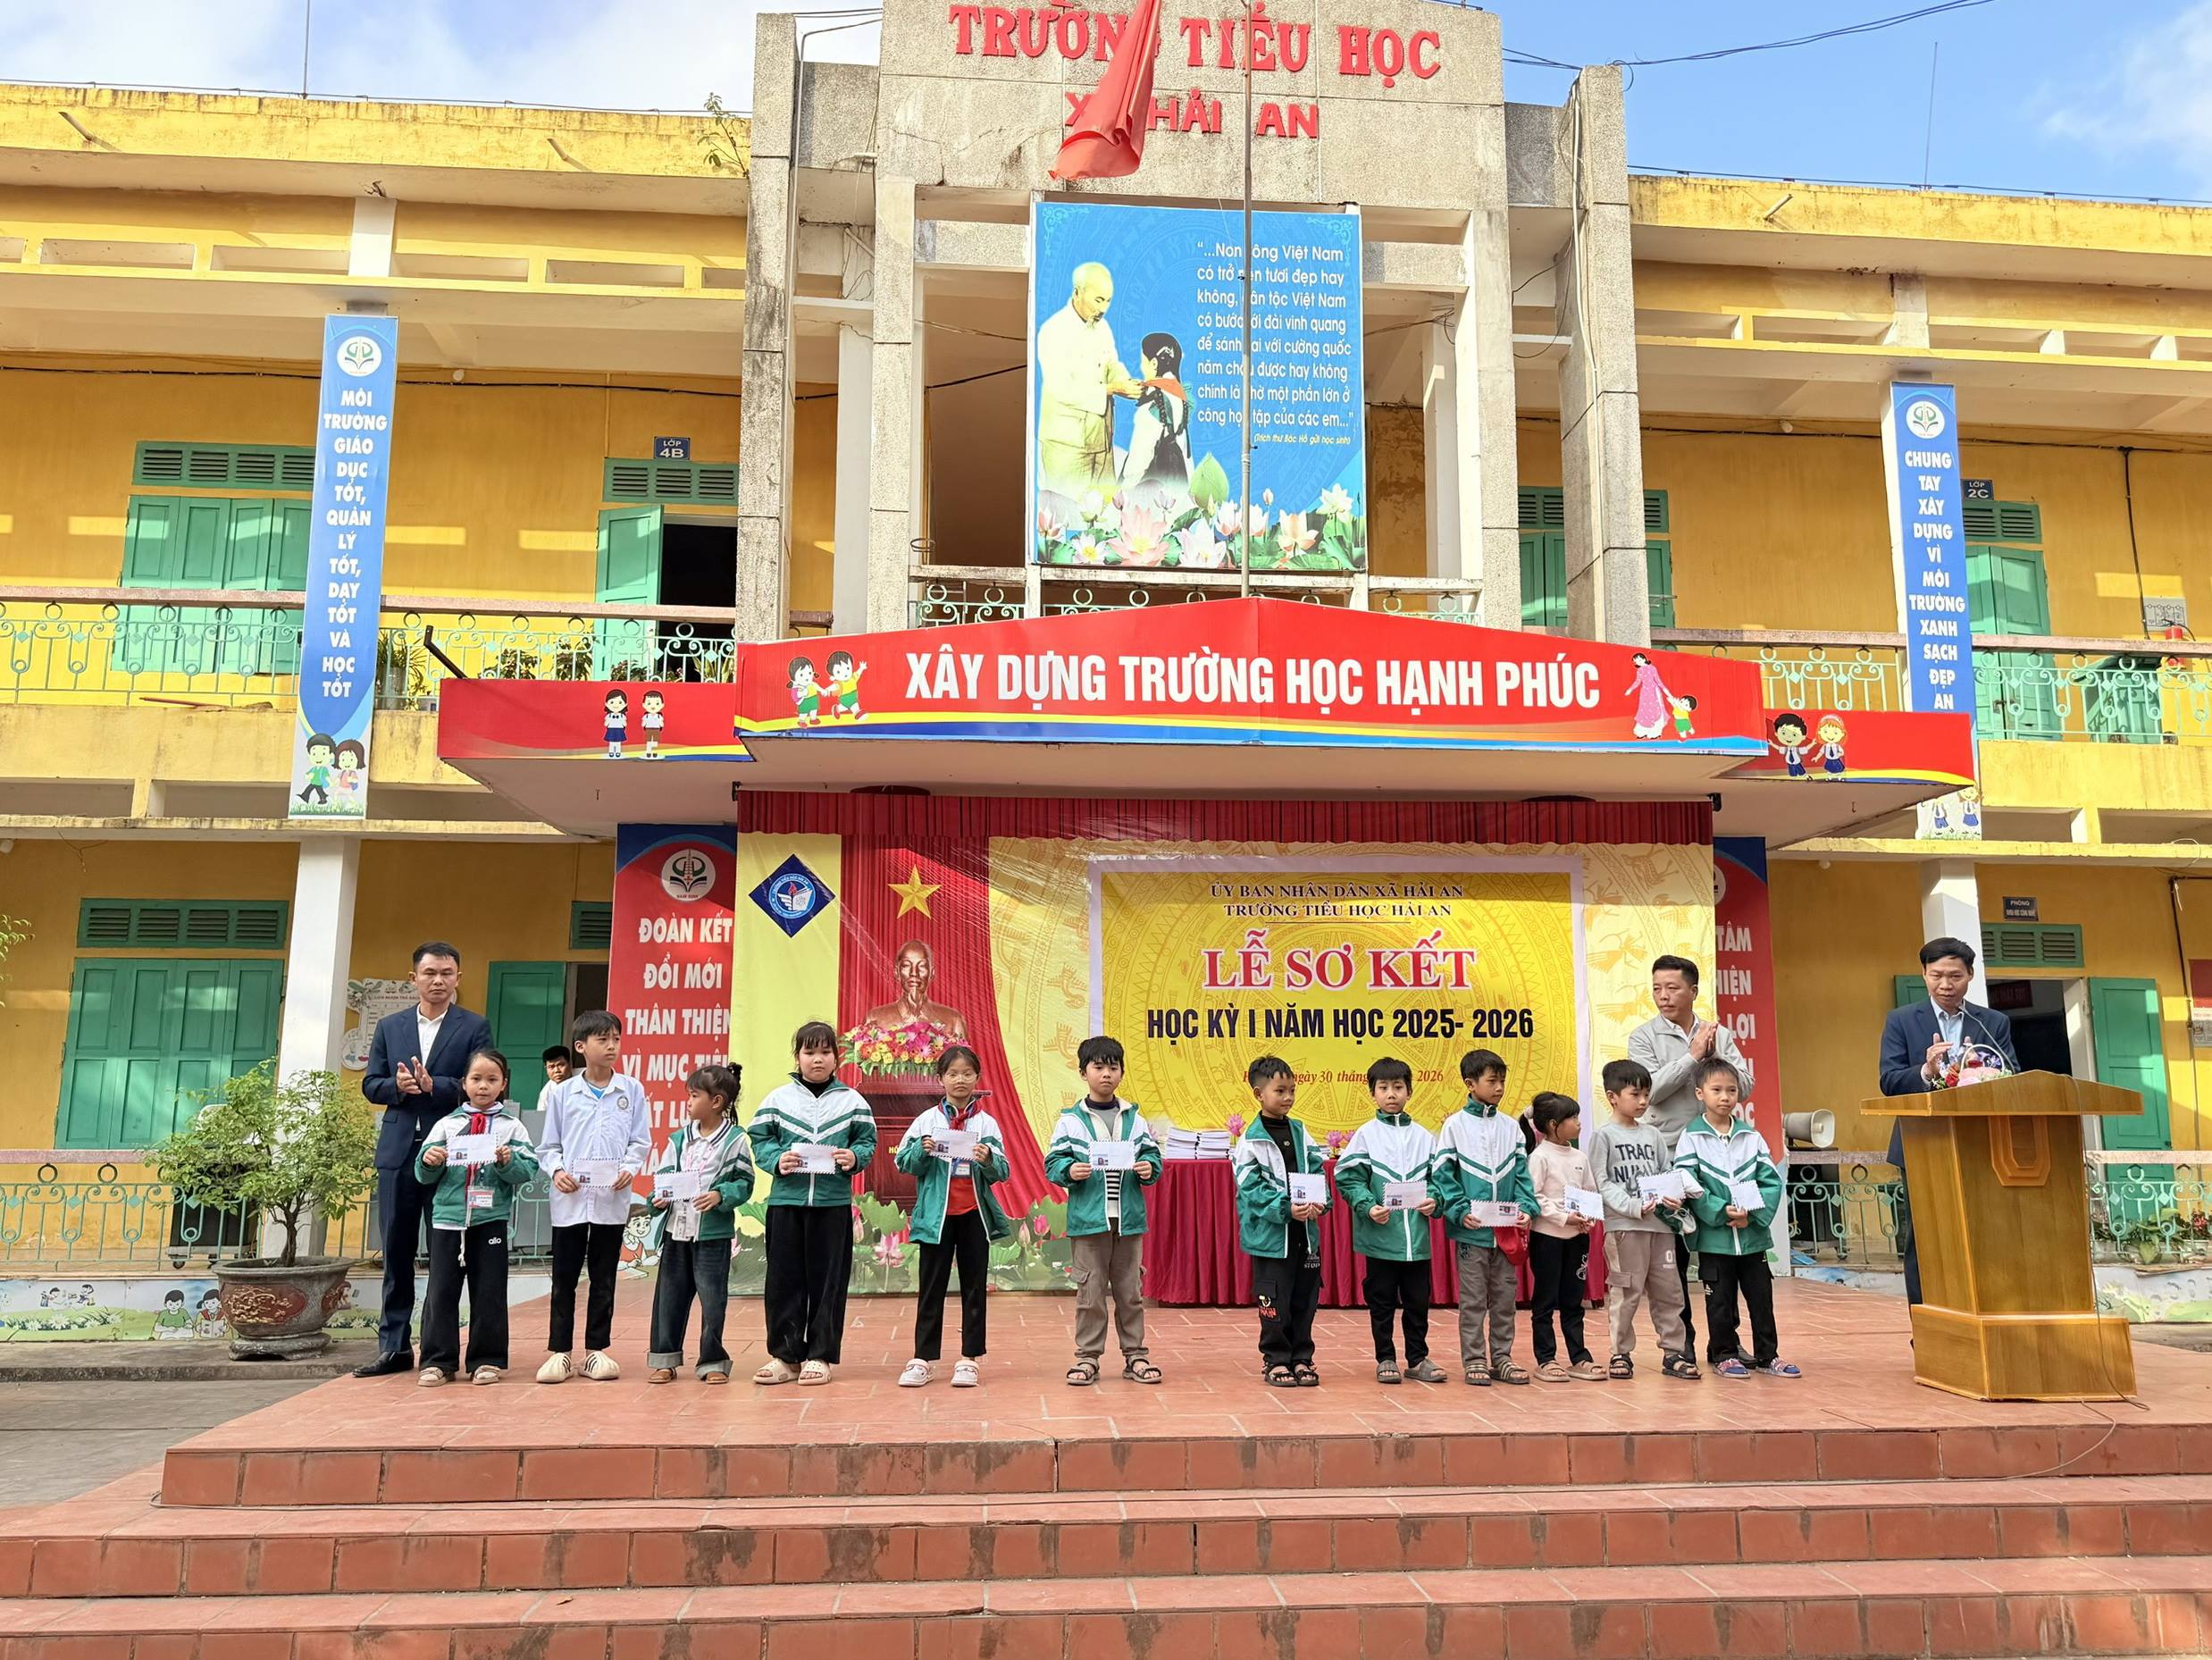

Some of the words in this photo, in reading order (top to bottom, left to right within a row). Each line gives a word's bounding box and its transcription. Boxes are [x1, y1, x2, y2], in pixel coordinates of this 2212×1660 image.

[949, 0, 1160, 61] TRƯỜN
[1179, 2, 1311, 72] TIỂU
[1336, 25, 1440, 88] HỌC
[1148, 88, 1221, 133] HẢI
[1256, 104, 1319, 138] AN
[1252, 243, 1278, 263] ông
[1282, 245, 1308, 263] Việt
[1312, 246, 1344, 262] Nam
[1197, 264, 1214, 281] có
[1217, 263, 1235, 281] trở
[1265, 269, 1288, 283] tươi
[1292, 271, 1318, 286] đẹp
[1321, 272, 1345, 288] hay
[1197, 288, 1238, 308] không,
[1242, 289, 1266, 305] ân
[1269, 292, 1288, 309] tộc
[1292, 292, 1316, 309] Việt
[1319, 294, 1346, 308] Nam
[1197, 311, 1212, 328] có
[1215, 312, 1244, 329] bước
[1251, 313, 1261, 329] ới
[1264, 313, 1282, 331] đài
[1285, 314, 1307, 331] vinh
[1311, 319, 1346, 335] quang
[1197, 331, 1213, 351] để
[1215, 336, 1242, 352] sánh
[1251, 338, 1262, 353] ai
[1264, 336, 1281, 352] với
[1285, 339, 1320, 357] cường
[1322, 339, 1352, 361] quốc
[1197, 359, 1223, 374] năm
[1257, 361, 1286, 379] được
[1289, 363, 1309, 381] hay
[1312, 363, 1348, 382] không
[340, 387, 373, 407] MÔI
[1197, 383, 1227, 399] chính
[1230, 384, 1240, 399] là
[1251, 385, 1264, 400] hờ
[1268, 387, 1288, 402] một
[1291, 386, 1320, 405] phần
[1322, 386, 1340, 402] lớn
[1343, 386, 1351, 403] ở
[323, 411, 388, 431] TRƯỜNG
[1197, 407, 1226, 426] công
[1229, 407, 1243, 427] họ
[1252, 408, 1269, 428] tập
[1274, 407, 1295, 425] của
[1297, 410, 1320, 426] các
[334, 435, 373, 455] GIÁO
[659, 448, 684, 458] 4B
[663, 438, 682, 447] LỚP
[1905, 450, 1952, 469] CHUNG
[336, 462, 368, 481] DỤC
[334, 477, 366, 506] TỐT,
[1919, 475, 1942, 491] TAY
[1967, 489, 1990, 499] 2C
[326, 507, 372, 526] QUẢN
[1918, 496, 1945, 516] XÂY
[338, 531, 357, 549] LÝ
[1913, 522, 1953, 543] DỰNG
[1926, 543, 1941, 564] VÌ
[329, 556, 362, 579] TỐT,
[1922, 568, 1950, 588] MÔI
[328, 583, 360, 601] DẠY
[1908, 591, 1965, 613] TRƯỜNG
[328, 599, 357, 624] TỐT
[1920, 618, 1958, 637] XANH
[330, 629, 351, 649] VÀ
[1923, 642, 1958, 664] SẠCH
[322, 657, 356, 676] HỌC
[322, 673, 352, 698] TỐT
[905, 643, 984, 700] XÂY
[997, 650, 1107, 710] DỰNG
[1119, 646, 1274, 704] TRƯỜNG
[1286, 658, 1363, 715] HỌC
[1377, 659, 1483, 716] HẠNH
[1496, 652, 1600, 708] PHÚC
[1929, 668, 1956, 690] ĐẸP
[1933, 692, 1954, 710] AN
[1211, 881, 1234, 897] ỦY
[1240, 885, 1275, 897] BAN
[1279, 882, 1329, 897] NHÂN
[1334, 882, 1370, 897] DÂN
[1375, 883, 1399, 897] XÃ
[1403, 882, 1434, 897] HẢI
[1439, 885, 1463, 897] AN
[1224, 900, 1297, 917] TRƯỜNG
[1303, 899, 1344, 917] TIỂU
[1349, 904, 1387, 919] HỌC
[1392, 901, 1422, 917] HẢI
[1428, 904, 1452, 917] AN
[639, 913, 693, 943] ĐOÀN
[700, 910, 733, 943] KẾT
[1715, 920, 1753, 952] TÂM
[1202, 928, 1272, 990] LỄ
[1286, 944, 1354, 991] SƠ
[1368, 928, 1477, 990] KẾT
[643, 952, 678, 989] ĐỔI
[684, 957, 722, 989] MỚI
[625, 1002, 676, 1035] THÂN
[1148, 1008, 1199, 1044] HỌC
[1208, 1002, 1239, 1038] KỲ
[1250, 1009, 1256, 1038] I
[1265, 1002, 1323, 1038] NĂM
[1334, 1008, 1385, 1044] HỌC
[1392, 1008, 1464, 1039] 2025-
[1472, 1008, 1534, 1039] 2026
[646, 1053, 690, 1088] MỤC
[1319, 1071, 1332, 1083] 30
[1336, 1070, 1369, 1085] tháng
[1416, 1069, 1444, 1082] 2026
